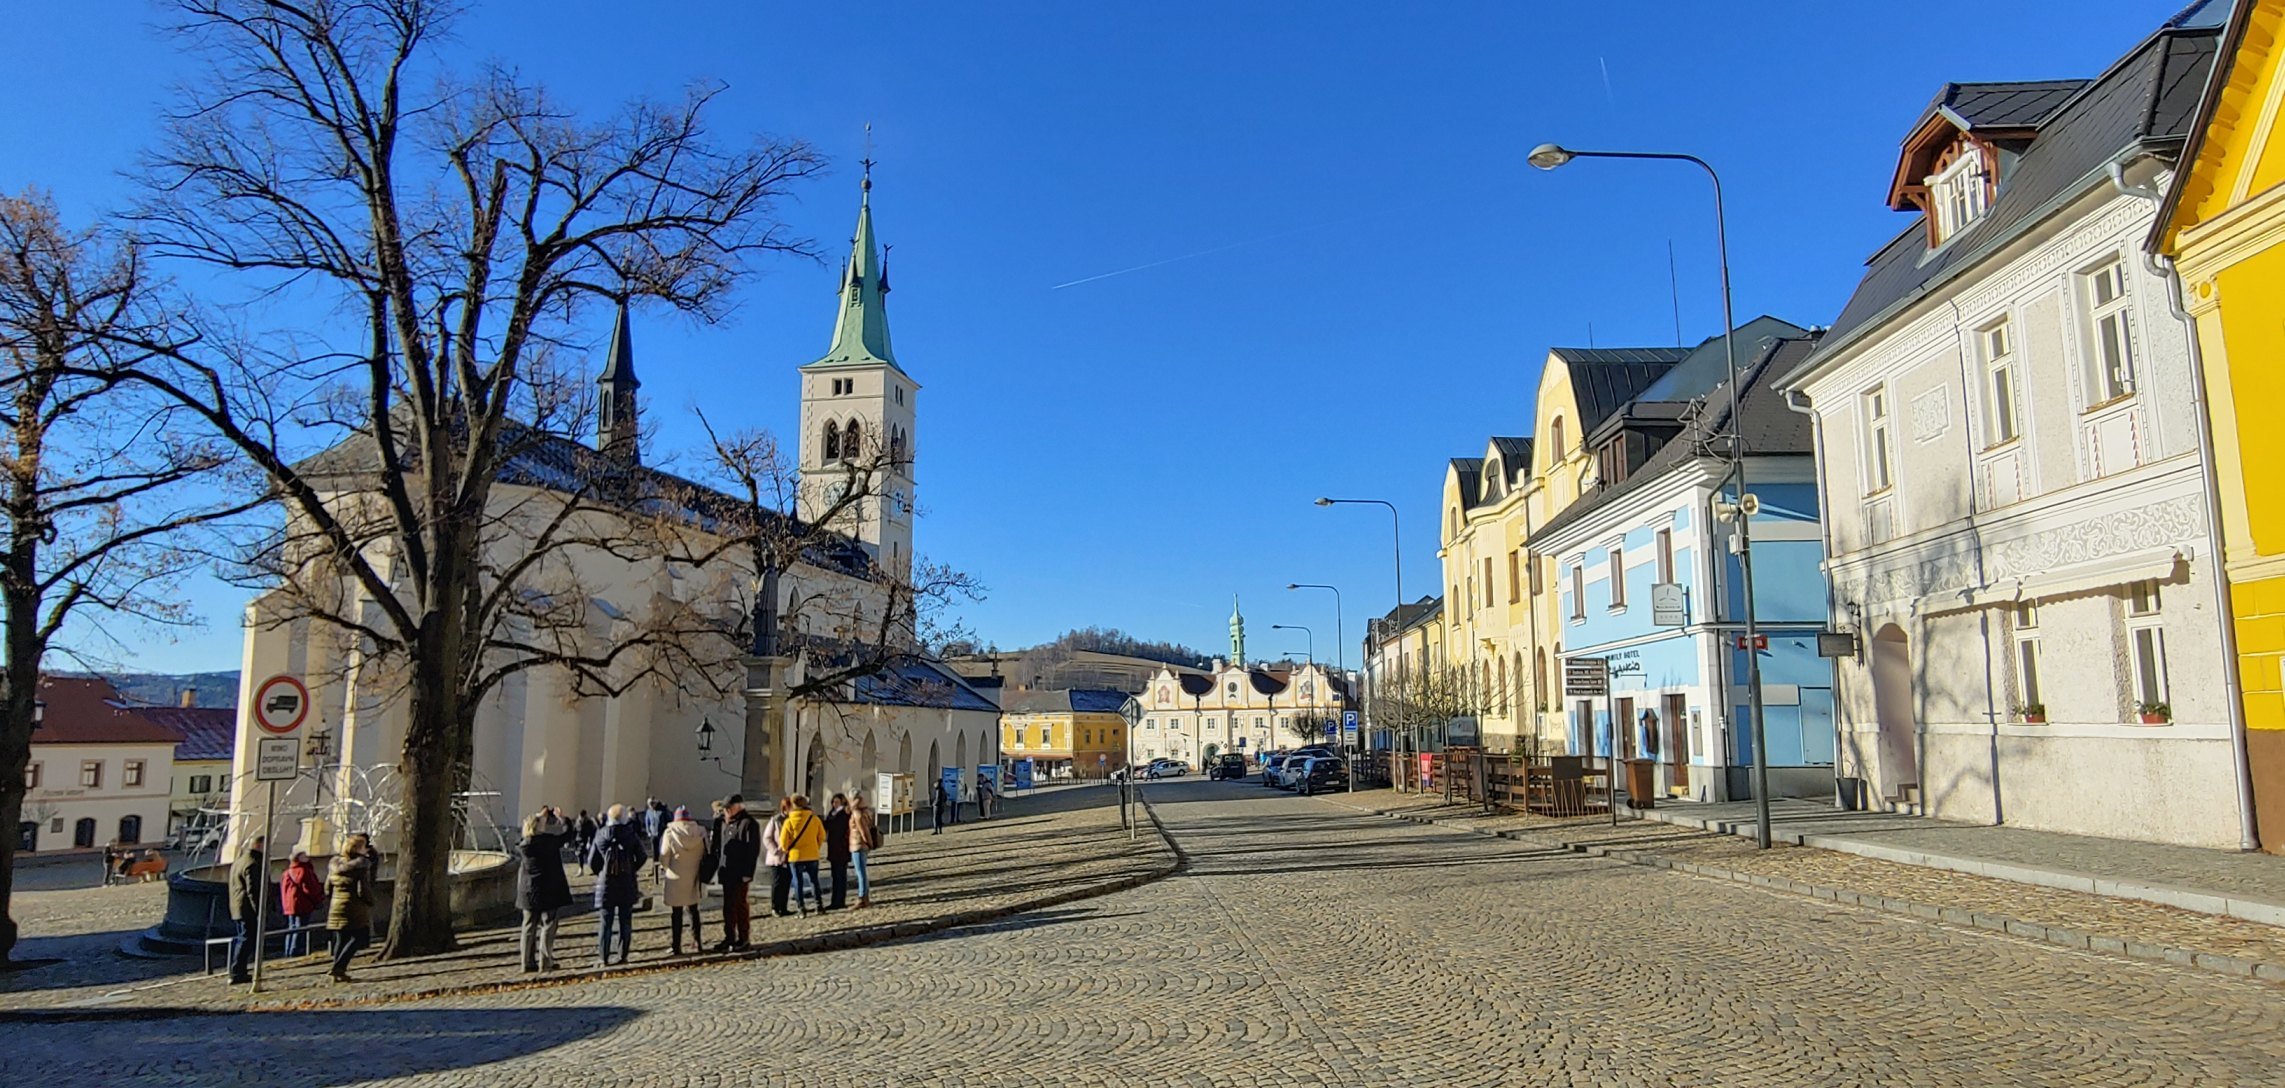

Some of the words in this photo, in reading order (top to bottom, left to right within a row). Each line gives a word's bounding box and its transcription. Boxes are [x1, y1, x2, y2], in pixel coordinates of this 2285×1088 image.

[1624, 650, 1640, 659] HOTEL
[1346, 713, 1355, 725] P
[1327, 721, 1335, 731] P
